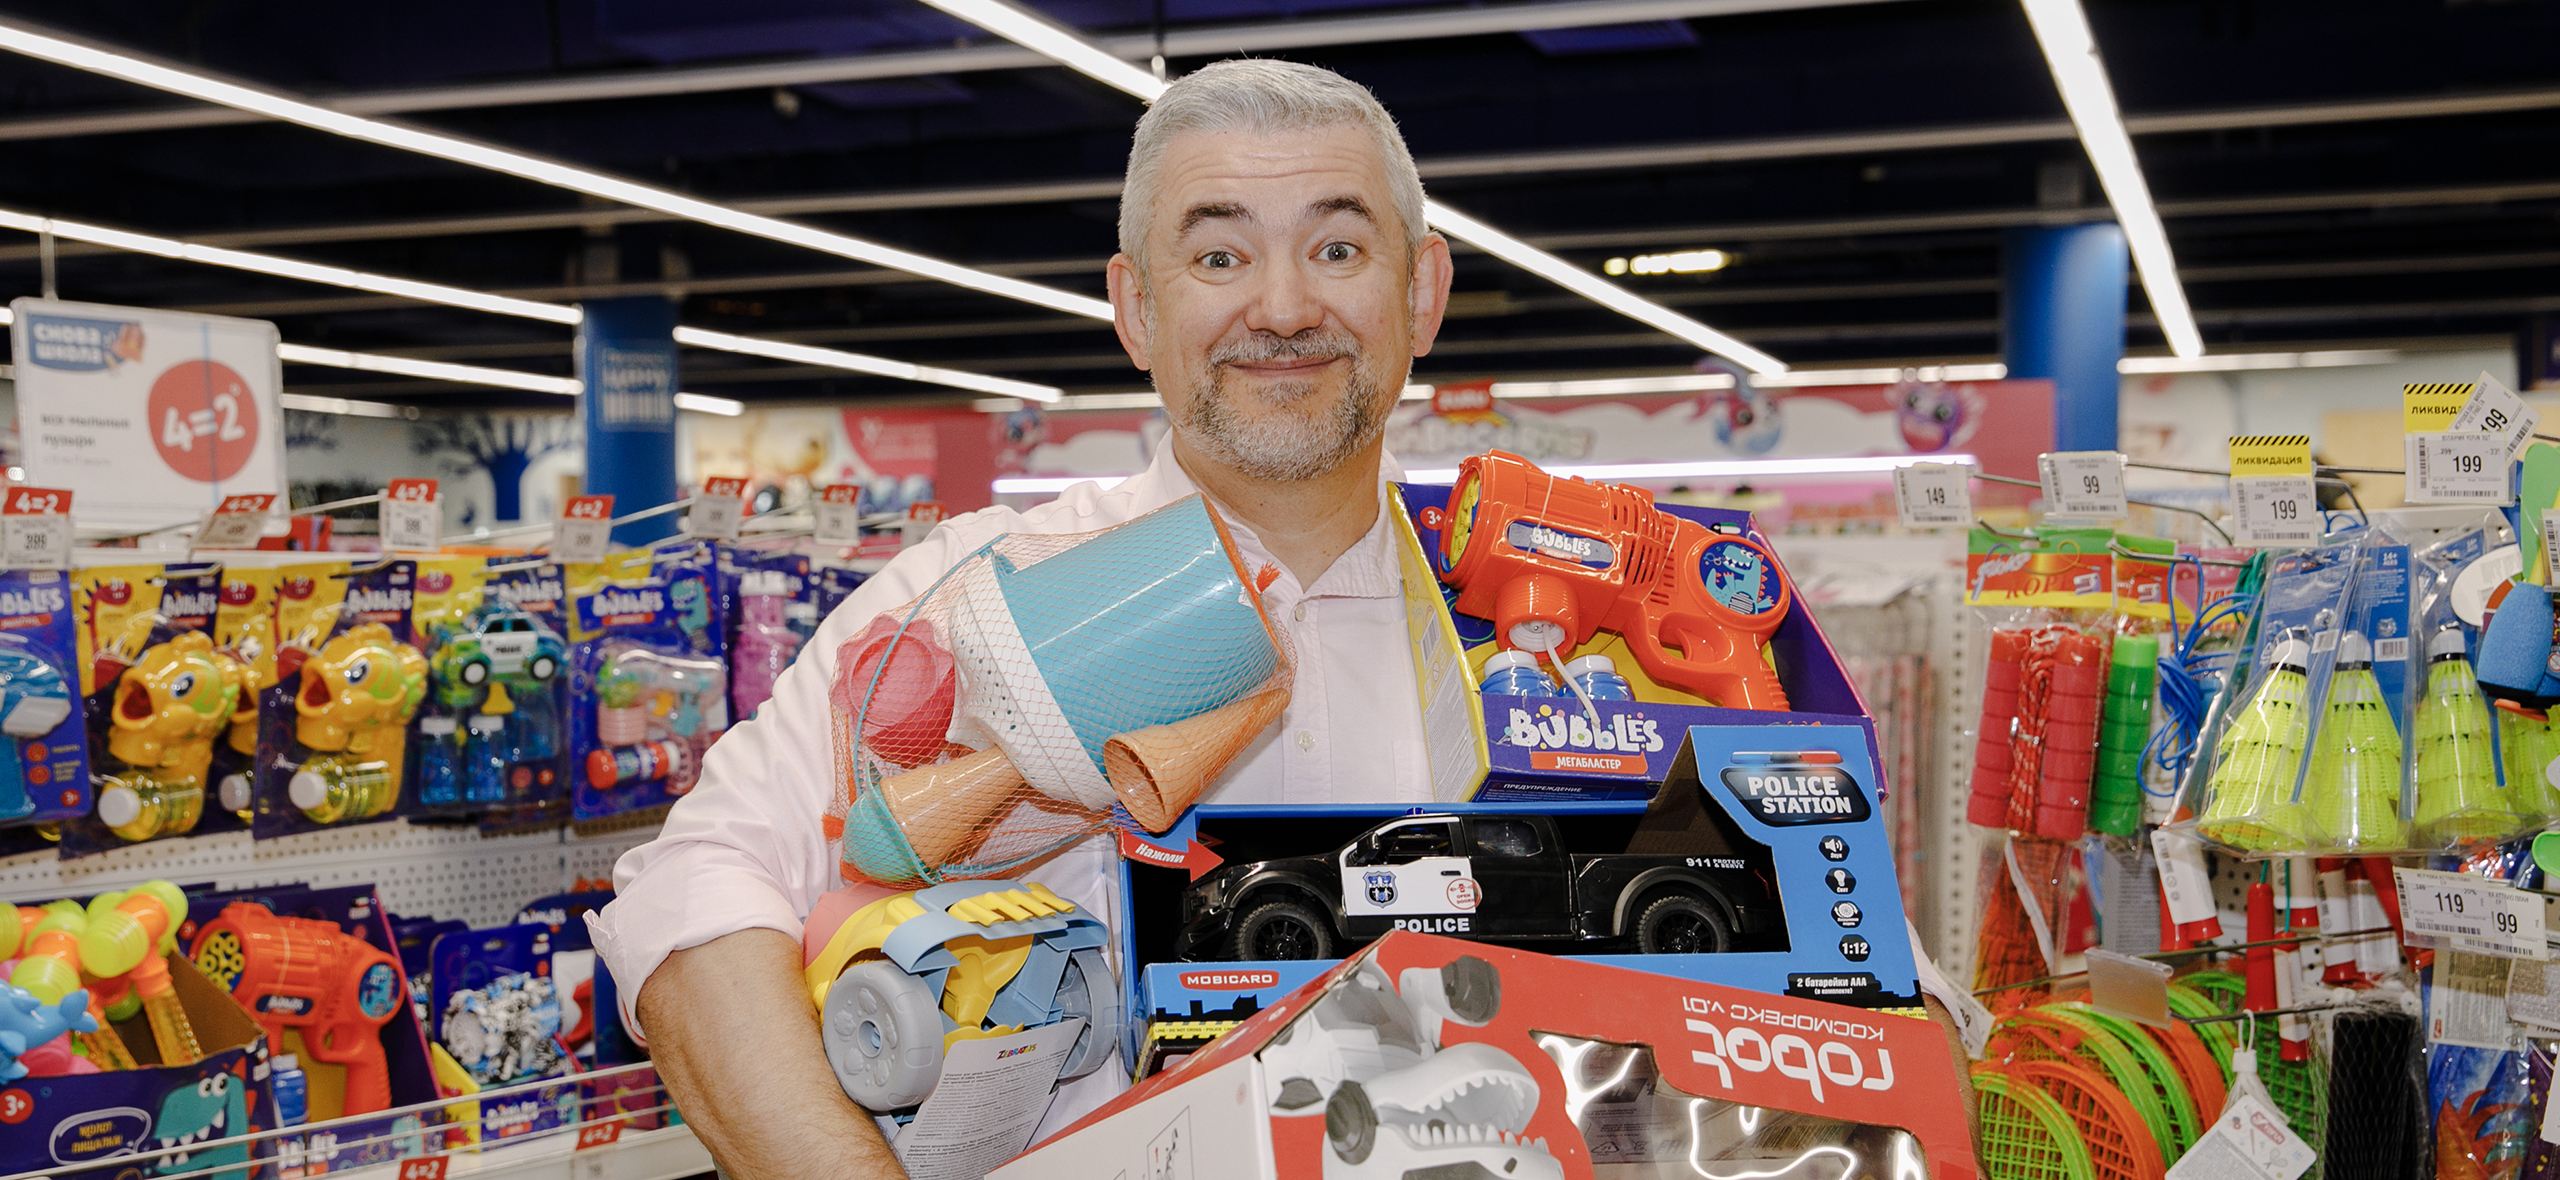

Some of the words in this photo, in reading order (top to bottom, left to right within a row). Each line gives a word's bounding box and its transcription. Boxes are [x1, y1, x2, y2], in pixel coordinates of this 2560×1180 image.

[2411, 405, 2461, 416] ликвид
[2453, 455, 2482, 473] 199
[2083, 475, 2100, 493] 99
[15, 491, 59, 515] 4=2
[1925, 487, 1945, 505] 149
[1427, 510, 1442, 525] 3+
[2271, 500, 2297, 519] 199
[1509, 707, 1664, 752] BUBBLES
[1555, 756, 1622, 769] МЕГАБЛАСТЕР
[1503, 783, 1583, 793] ПРЕДУПРЕЖДЕНИЕ
[1747, 776, 1839, 796] POLICE
[1762, 797, 1852, 814] STATION
[1135, 842, 1185, 864] Нажми
[1686, 857, 1711, 868] 911
[2435, 892, 2464, 913] 119
[1394, 918, 1470, 934] POLICE
[1842, 942, 1869, 955] 1:12
[1187, 974, 1273, 985] MOBICARO
[1796, 978, 1803, 987] 2
[1804, 977, 1849, 988] батарейки
[1850, 977, 1867, 987] AAA
[1730, 1004, 1884, 1042] КОСМОРЕКС
[996, 1043, 1038, 1060] ZEBRATOYS
[1685, 1018, 1895, 1104] robot
[4, 1094, 27, 1111] 3+
[405, 1160, 440, 1179] 4=2
